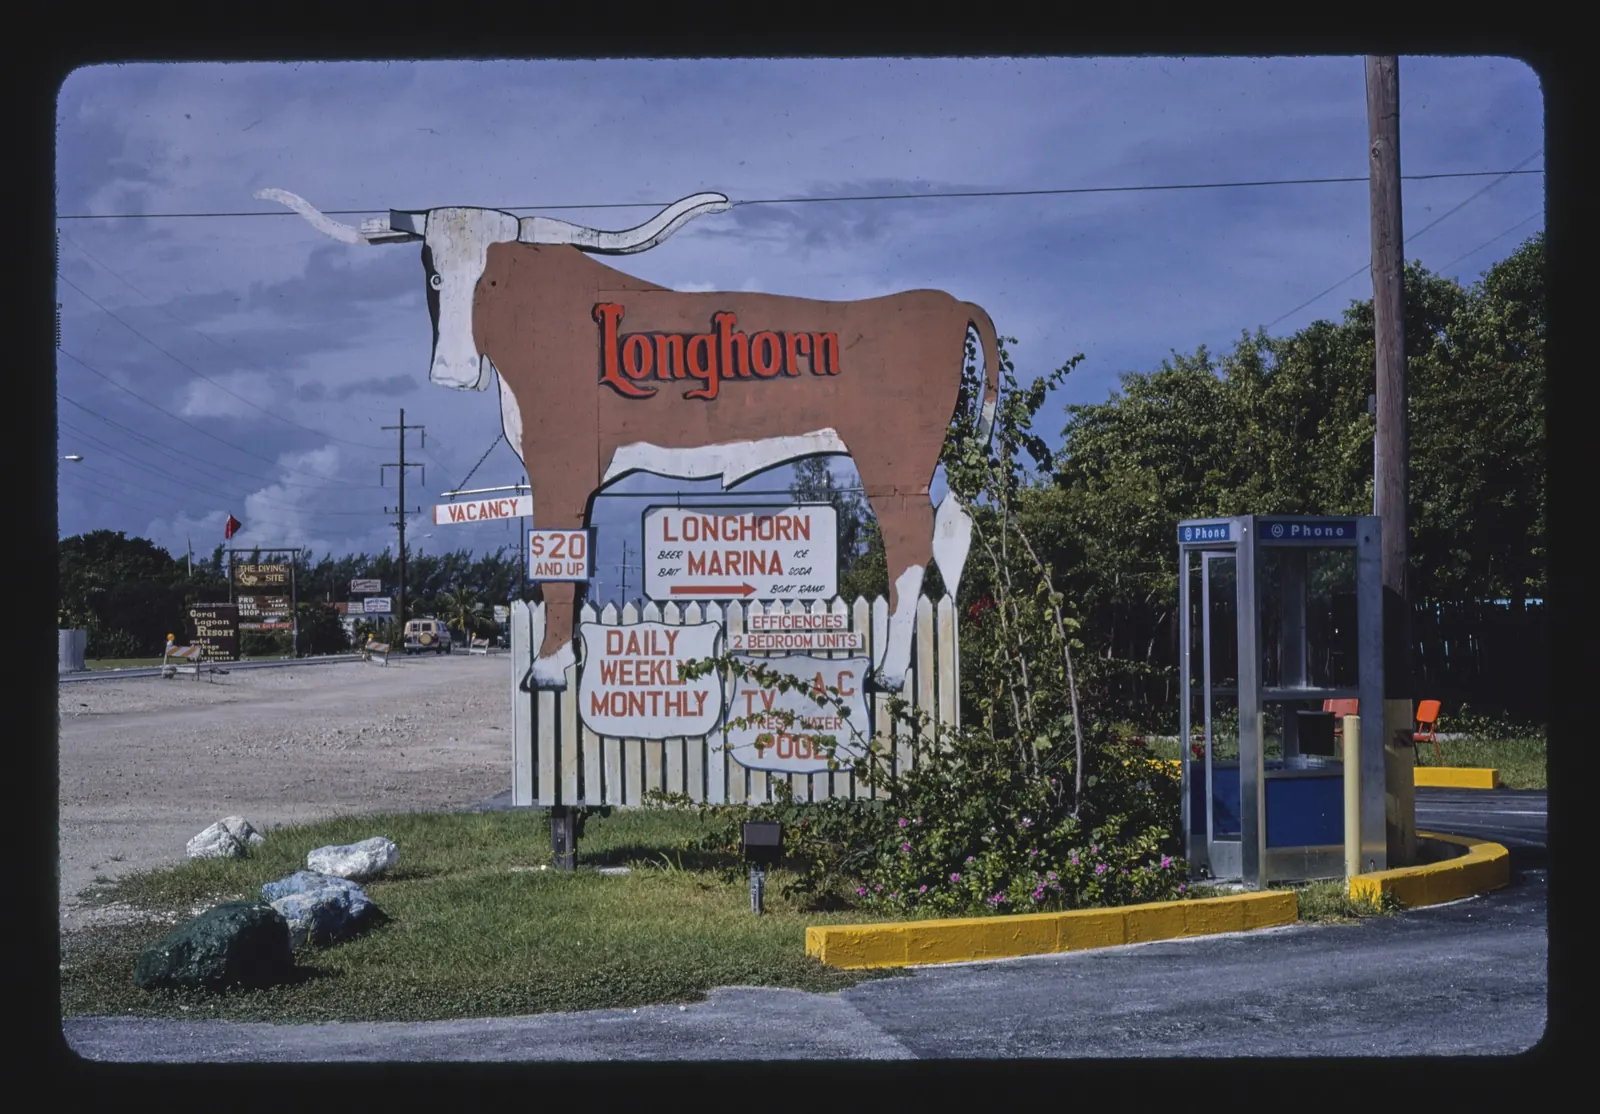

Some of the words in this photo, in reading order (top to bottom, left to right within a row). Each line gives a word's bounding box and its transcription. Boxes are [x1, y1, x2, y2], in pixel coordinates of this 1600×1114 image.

[592, 302, 840, 400] Longhorn
[448, 499, 518, 522] VACANCY
[664, 515, 810, 542] LONGHORN
[1195, 527, 1226, 539] Phone
[1291, 525, 1344, 536] Phone
[532, 533, 586, 559] $20
[658, 550, 683, 560] BEER
[794, 550, 810, 558] ICE
[535, 562, 562, 576] AND
[567, 562, 584, 576] UP
[688, 550, 783, 576] MARINA
[658, 568, 682, 577] BAIT
[788, 566, 812, 576] SODA
[770, 584, 797, 594] BOAT
[798, 584, 826, 594] RAMP
[190, 609, 216, 618] Coral
[194, 618, 229, 626] Lagoon
[752, 614, 842, 628] EFFICIENCIES
[606, 630, 680, 656] DAILY
[734, 635, 743, 648] 2
[748, 634, 812, 648] BEDROOM
[817, 634, 857, 648] UNITS
[591, 690, 708, 717] MONTHLY
[741, 690, 776, 717] TV
